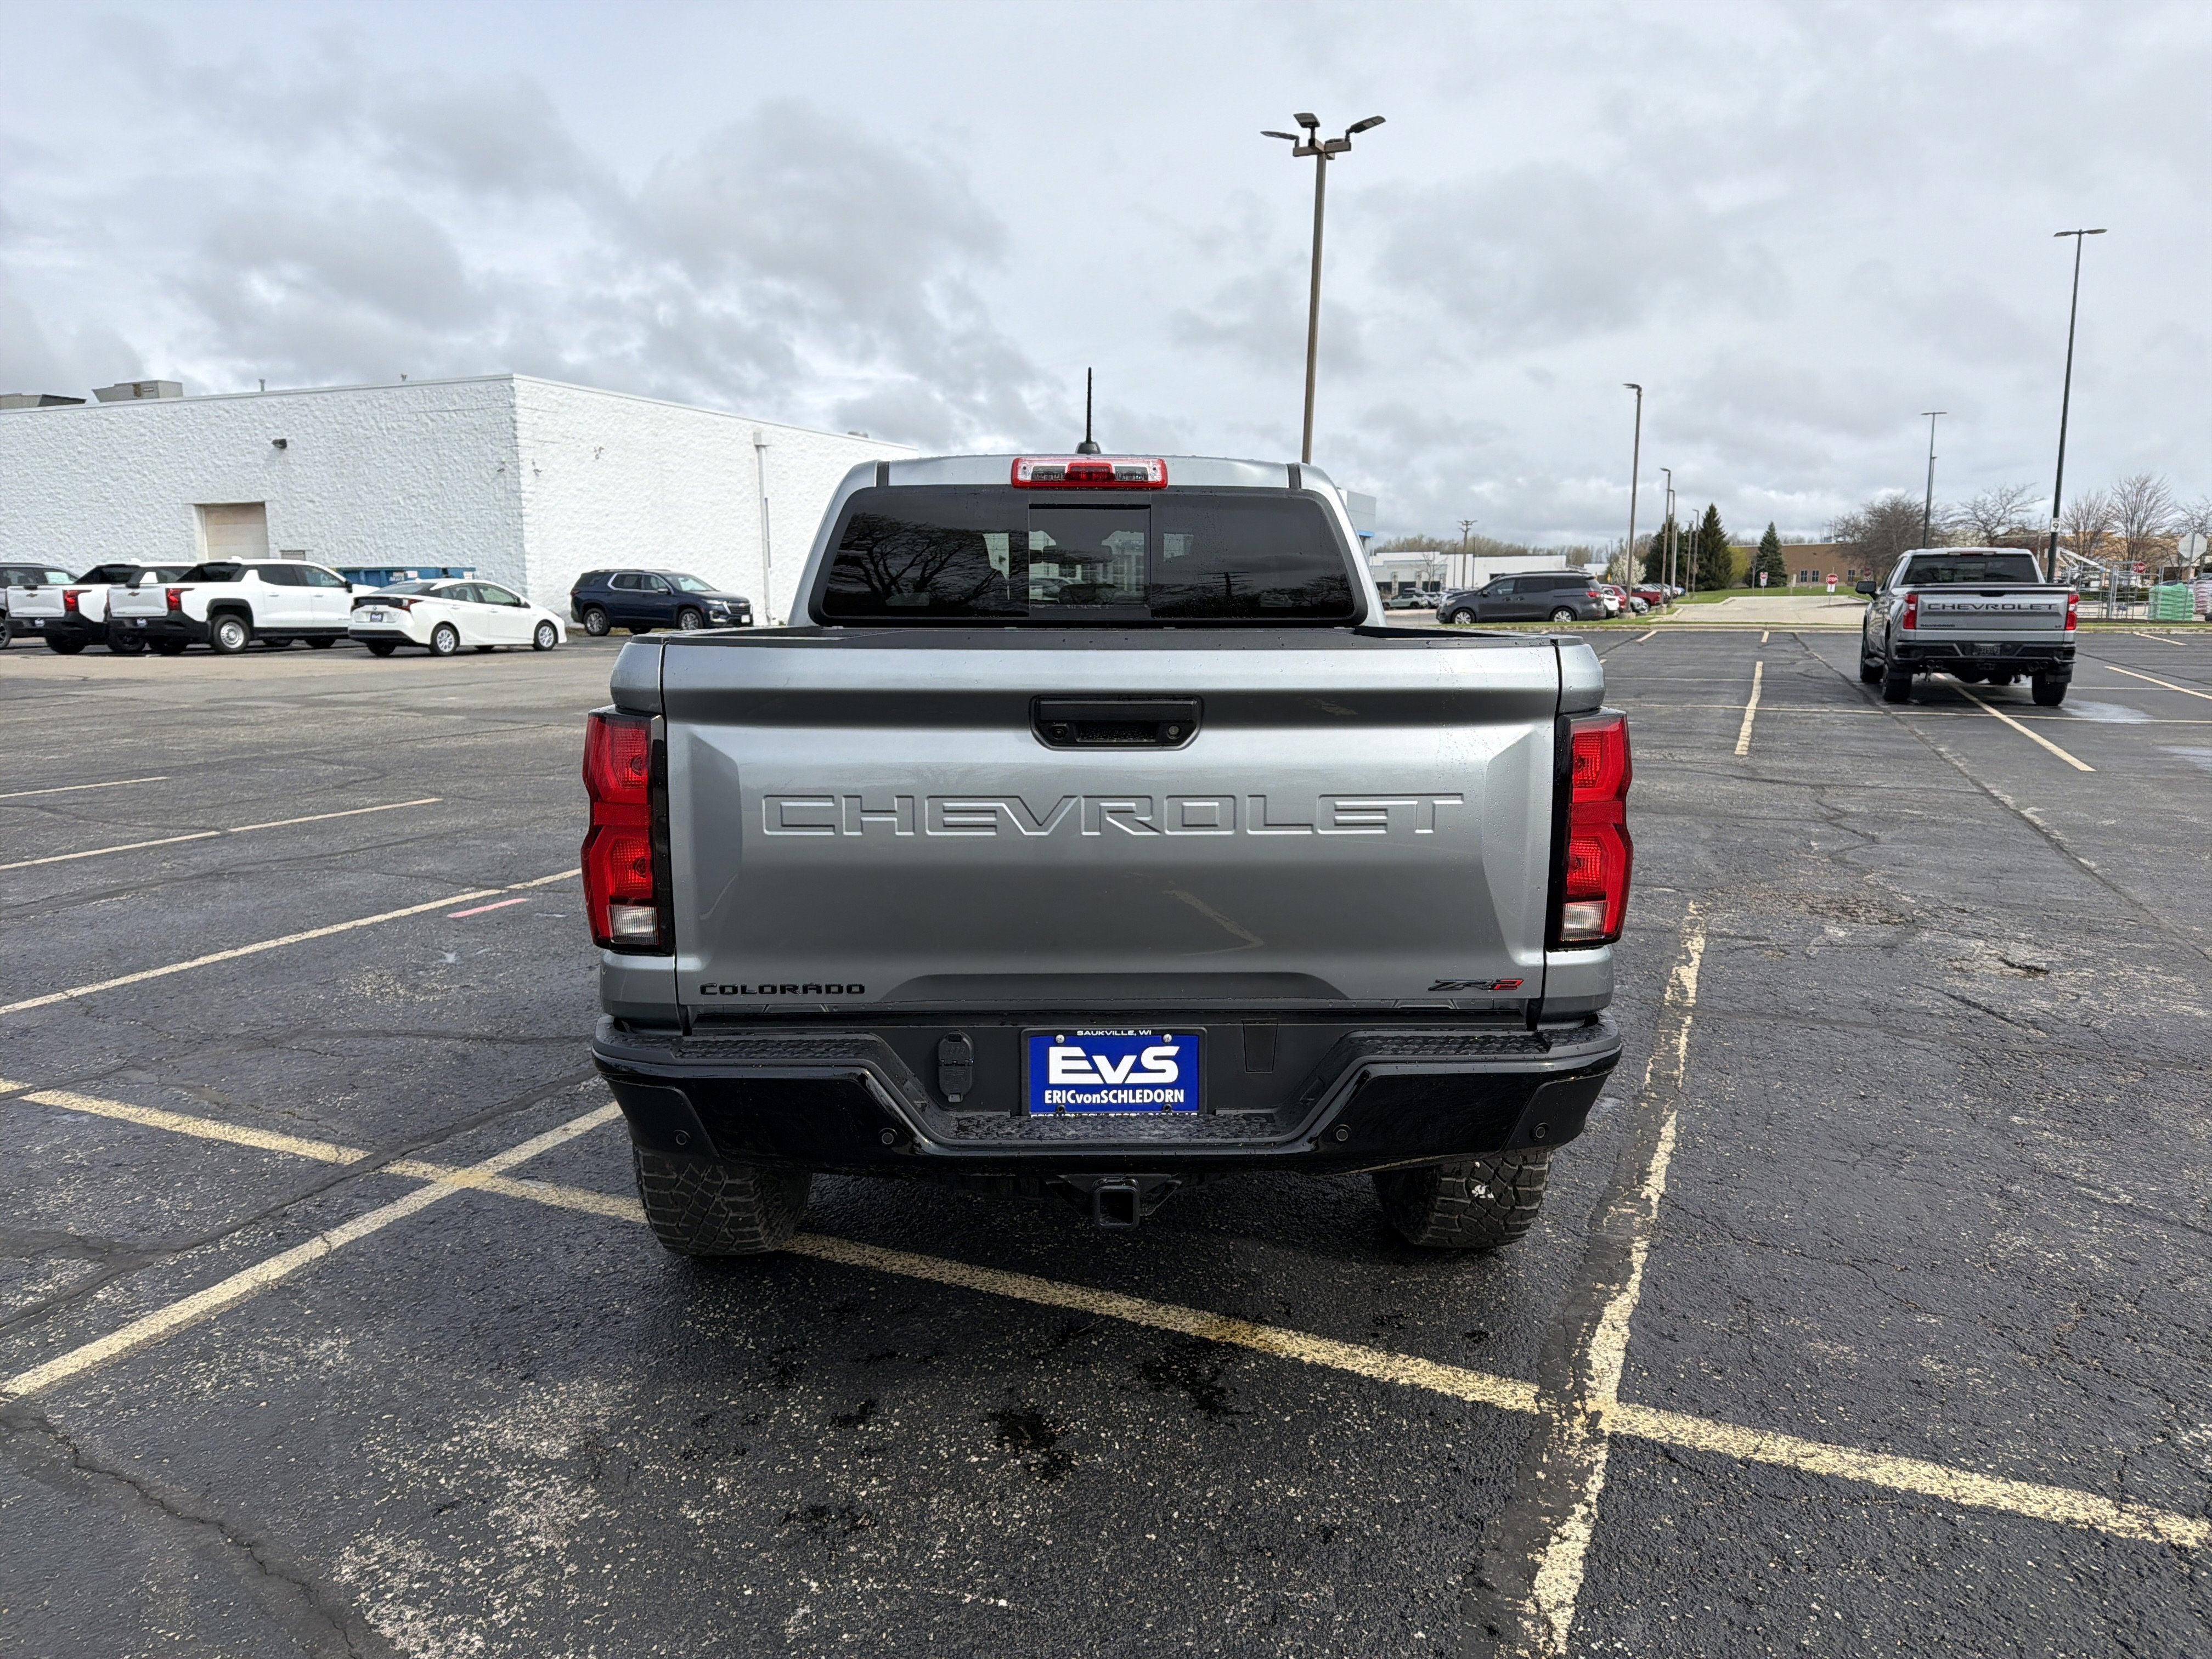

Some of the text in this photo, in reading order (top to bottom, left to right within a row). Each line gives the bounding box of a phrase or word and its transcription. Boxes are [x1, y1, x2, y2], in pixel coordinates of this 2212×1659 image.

[762, 793, 1464, 838] CHEVROLET
[699, 983, 865, 995] COLORADO
[1427, 978, 1524, 991] ZR2
[1045, 1089, 1184, 1104] ERICvonSCHLEDORN
